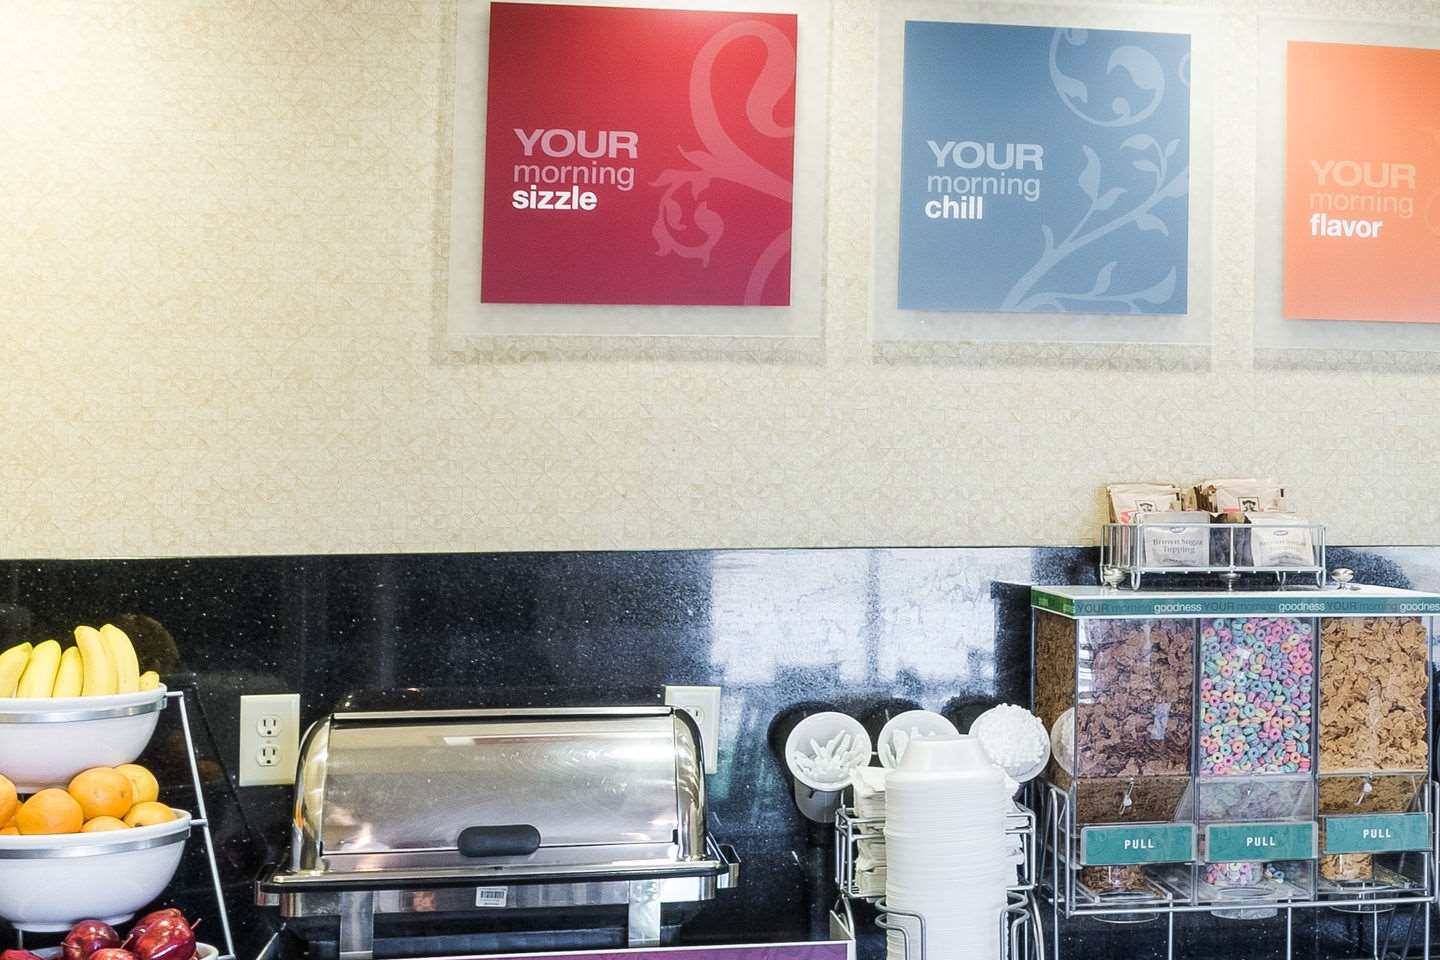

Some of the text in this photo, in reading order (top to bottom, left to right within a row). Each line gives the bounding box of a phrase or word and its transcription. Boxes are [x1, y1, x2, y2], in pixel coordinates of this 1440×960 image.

[513, 128, 639, 159] YOUR
[926, 140, 1044, 171] YOUR
[514, 160, 635, 191] morning
[927, 171, 1041, 202] morning
[1310, 159, 1416, 190] YOUR
[512, 184, 598, 210] sizzle
[924, 194, 984, 220] chill
[1309, 190, 1414, 219] morning
[1309, 212, 1383, 238] flavor
[1153, 601, 1203, 614] goodness
[1278, 601, 1326, 613] goodness
[1123, 838, 1155, 850] PULL
[1246, 836, 1276, 847] PULL
[1362, 828, 1392, 839] PULL
